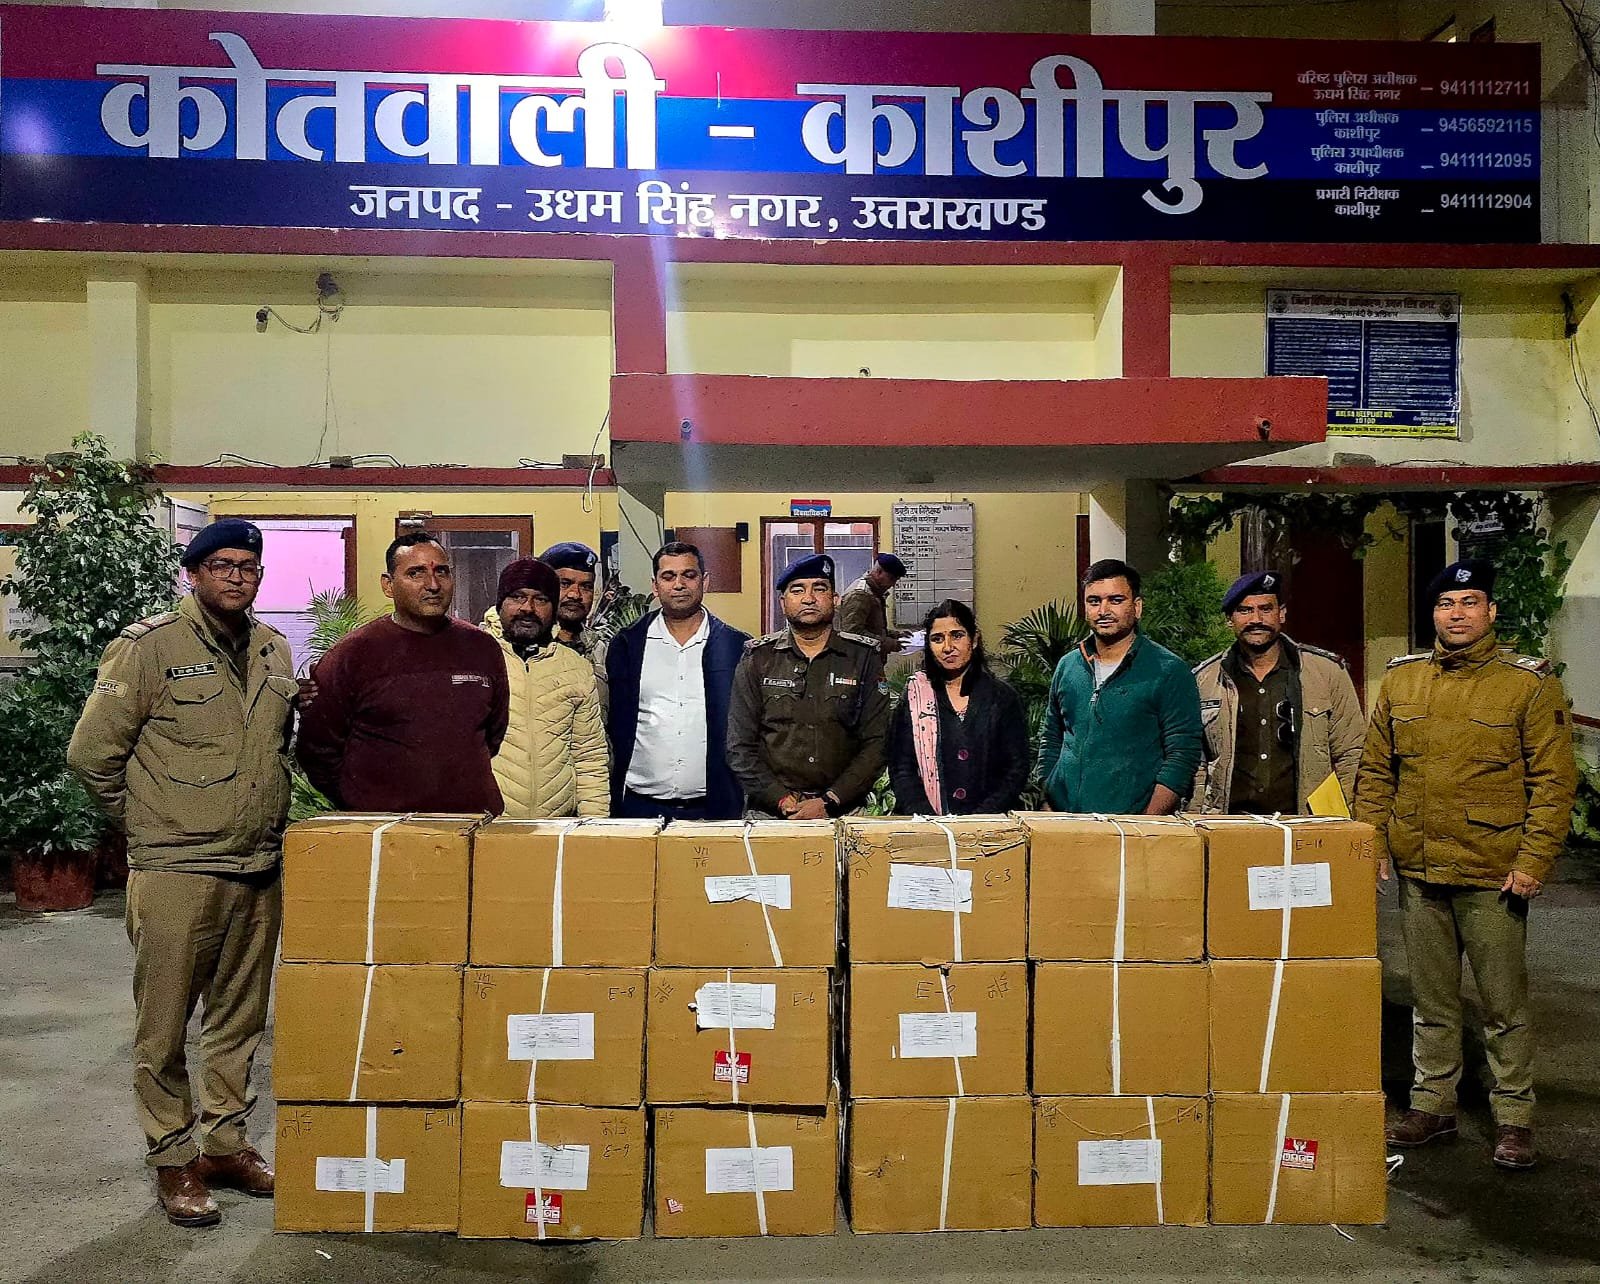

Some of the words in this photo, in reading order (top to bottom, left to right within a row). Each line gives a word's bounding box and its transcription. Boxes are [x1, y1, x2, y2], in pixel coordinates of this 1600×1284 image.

[1297, 70, 1330, 84] वरिष्ठ
[1333, 70, 1368, 87] पुलिस
[1372, 71, 1418, 85] अधीक्षक
[1374, 89, 1401, 100] नगर
[1440, 80, 1529, 96] 9411112711
[96, 32, 666, 170] कोतवाली
[796, 54, 1273, 215] काशीपुर
[1315, 109, 1349, 127] पुलिस
[1353, 109, 1400, 124] अधीक्षक
[1439, 118, 1533, 133] 9456592115
[1334, 125, 1381, 143] काशीपुर
[1311, 144, 1345, 161] पुलिस
[1349, 144, 1405, 159] उपाधीक्षक
[1440, 152, 1532, 168] 9411112095
[1334, 160, 1382, 178] काशीपुर
[1316, 186, 1350, 200] प्रभारी
[1354, 186, 1400, 200] निरीक्षक
[1440, 194, 1532, 209] 9411112904
[349, 184, 482, 224] जनपद
[526, 188, 622, 223] उधम
[636, 180, 715, 228] सिंह
[729, 192, 839, 233] नगर,
[851, 196, 1048, 232] उत्तराखण्ड
[1335, 201, 1381, 219] काशीपुर
